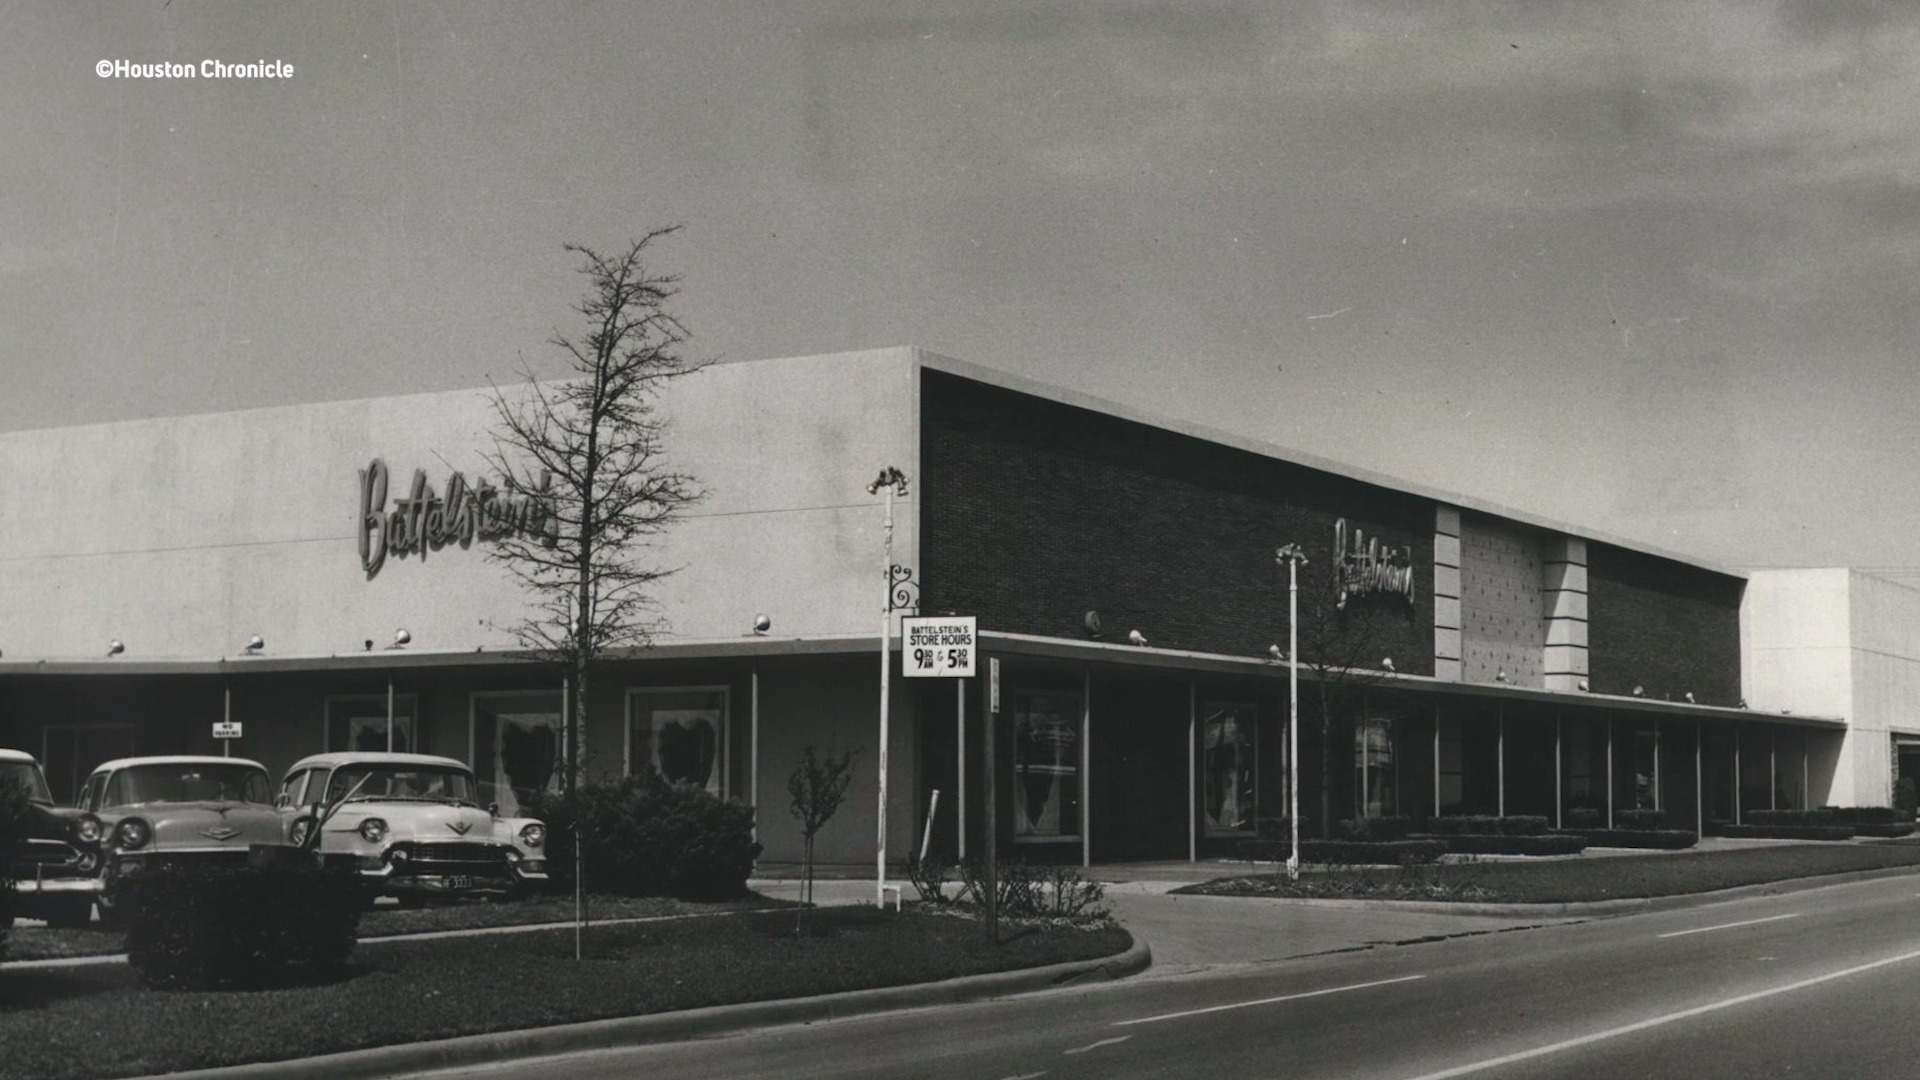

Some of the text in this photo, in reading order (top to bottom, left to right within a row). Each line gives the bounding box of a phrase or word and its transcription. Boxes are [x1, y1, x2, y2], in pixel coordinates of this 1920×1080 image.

[911, 625, 968, 634] BATTELSTEIN'S
[910, 634, 972, 646] STORE HOURS
[914, 648, 924, 669] 9
[948, 649, 957, 668] 5
